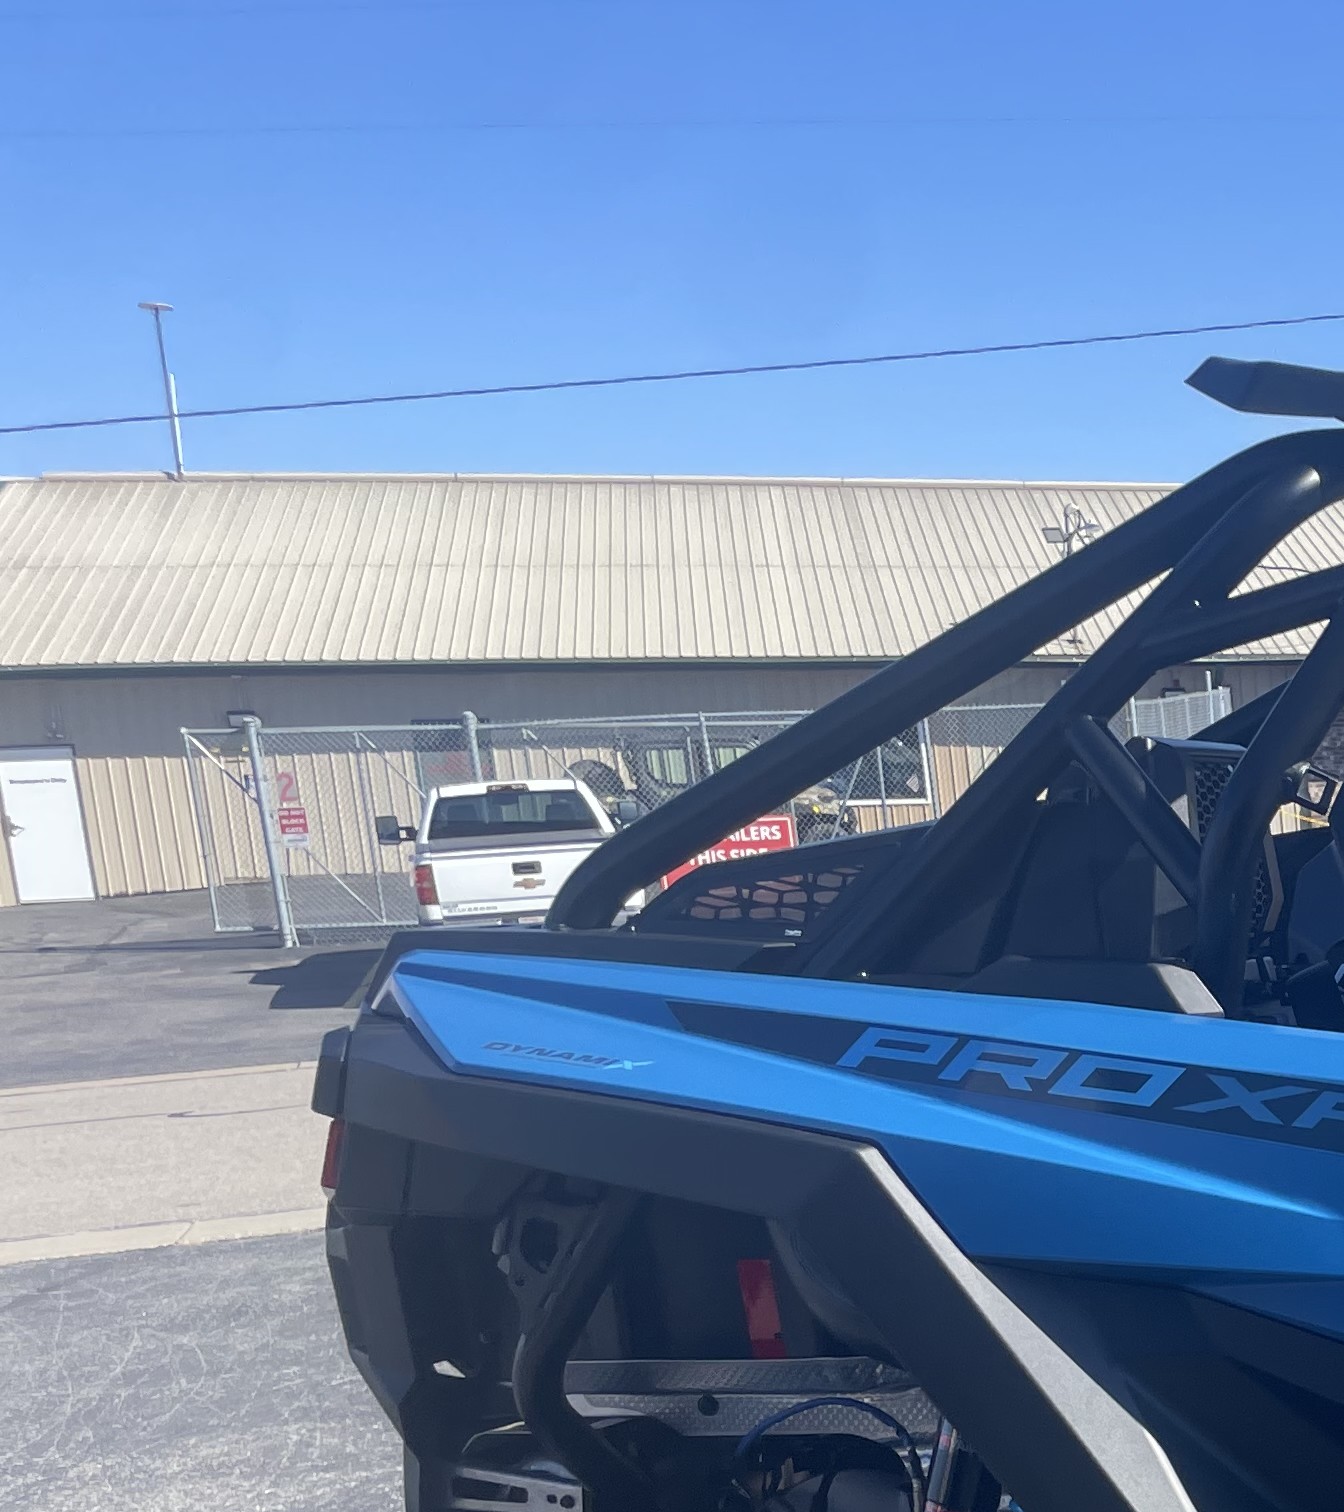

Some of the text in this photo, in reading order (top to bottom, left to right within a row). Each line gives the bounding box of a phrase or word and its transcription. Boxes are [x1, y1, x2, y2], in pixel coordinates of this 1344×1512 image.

[276, 772, 299, 801] 2
[482, 1041, 655, 1071] DYNAMIX
[836, 1026, 1187, 1108] PRO
